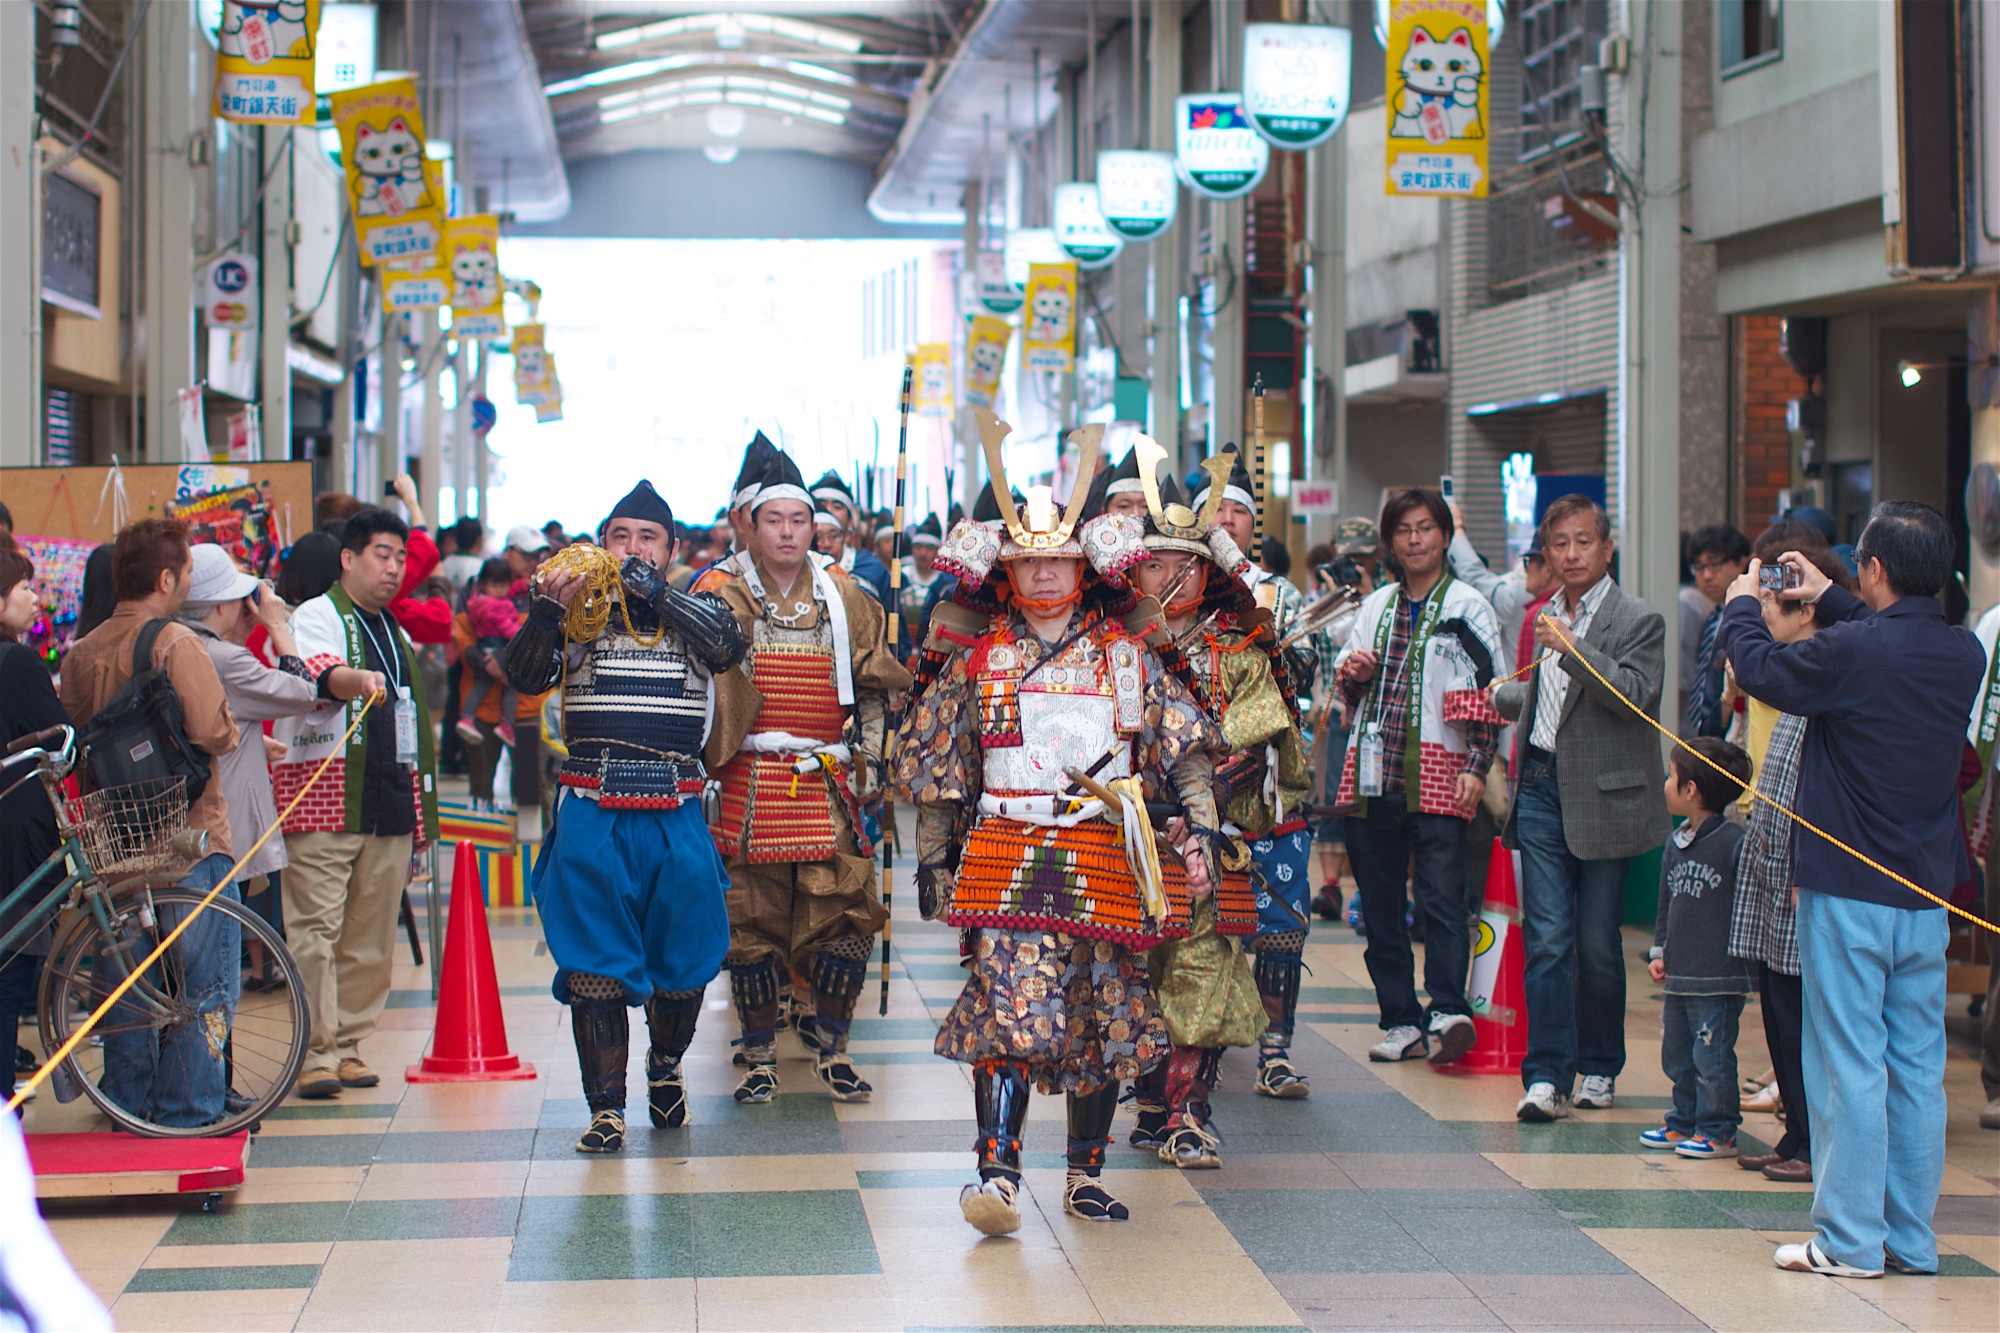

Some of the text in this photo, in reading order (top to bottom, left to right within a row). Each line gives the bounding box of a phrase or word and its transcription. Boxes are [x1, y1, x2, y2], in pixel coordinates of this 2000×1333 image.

[237, 79, 277, 92] 門司港
[221, 93, 297, 116] 栄町銀天街
[1417, 156, 1454, 168] 門司港
[1401, 171, 1471, 189] 栄町銀天街
[217, 268, 247, 287] UC
[292, 734, 308, 747] The
